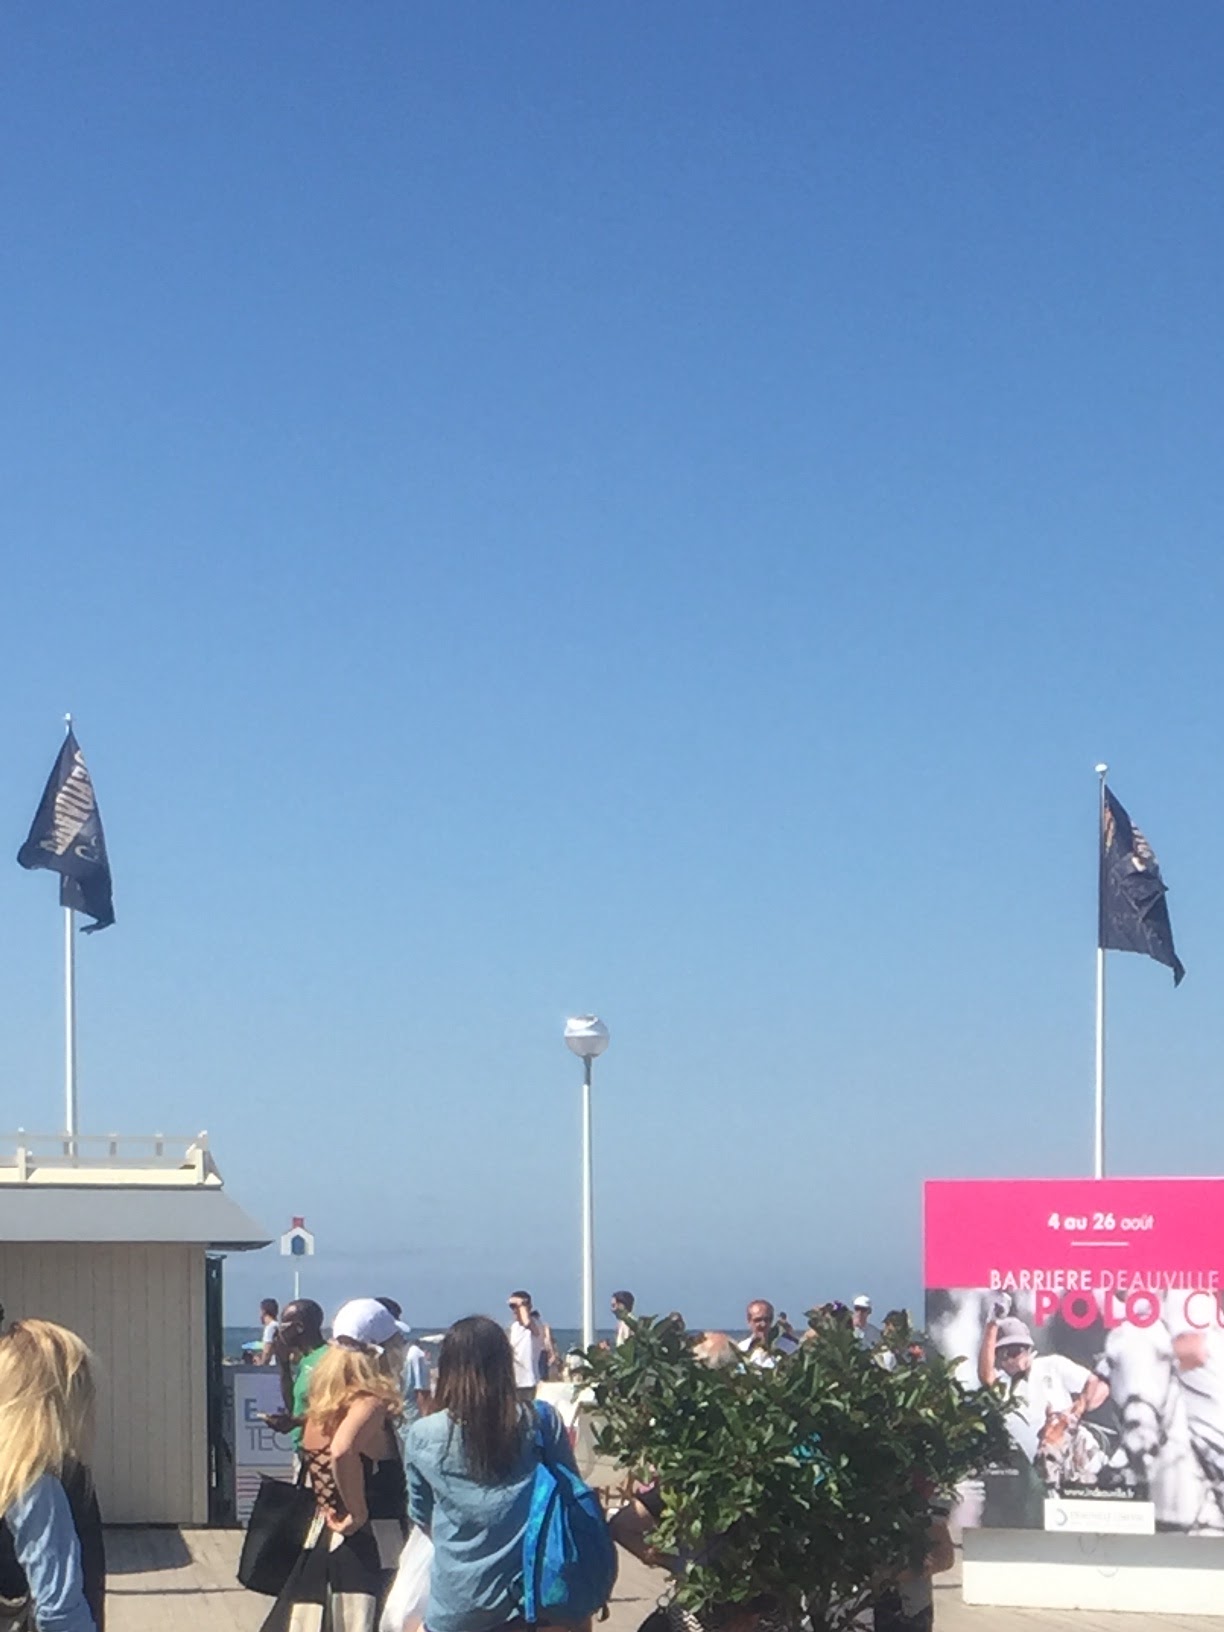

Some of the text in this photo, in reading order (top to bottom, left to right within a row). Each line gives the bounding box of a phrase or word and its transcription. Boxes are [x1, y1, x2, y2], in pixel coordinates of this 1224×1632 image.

[1047, 1213, 1060, 1230] 4
[1064, 1216, 1087, 1230] au
[1093, 1213, 1116, 1230] 26
[990, 1269, 1219, 1293] BARRIERE DEAUVILLE
[1035, 1290, 1161, 1330] POLO
